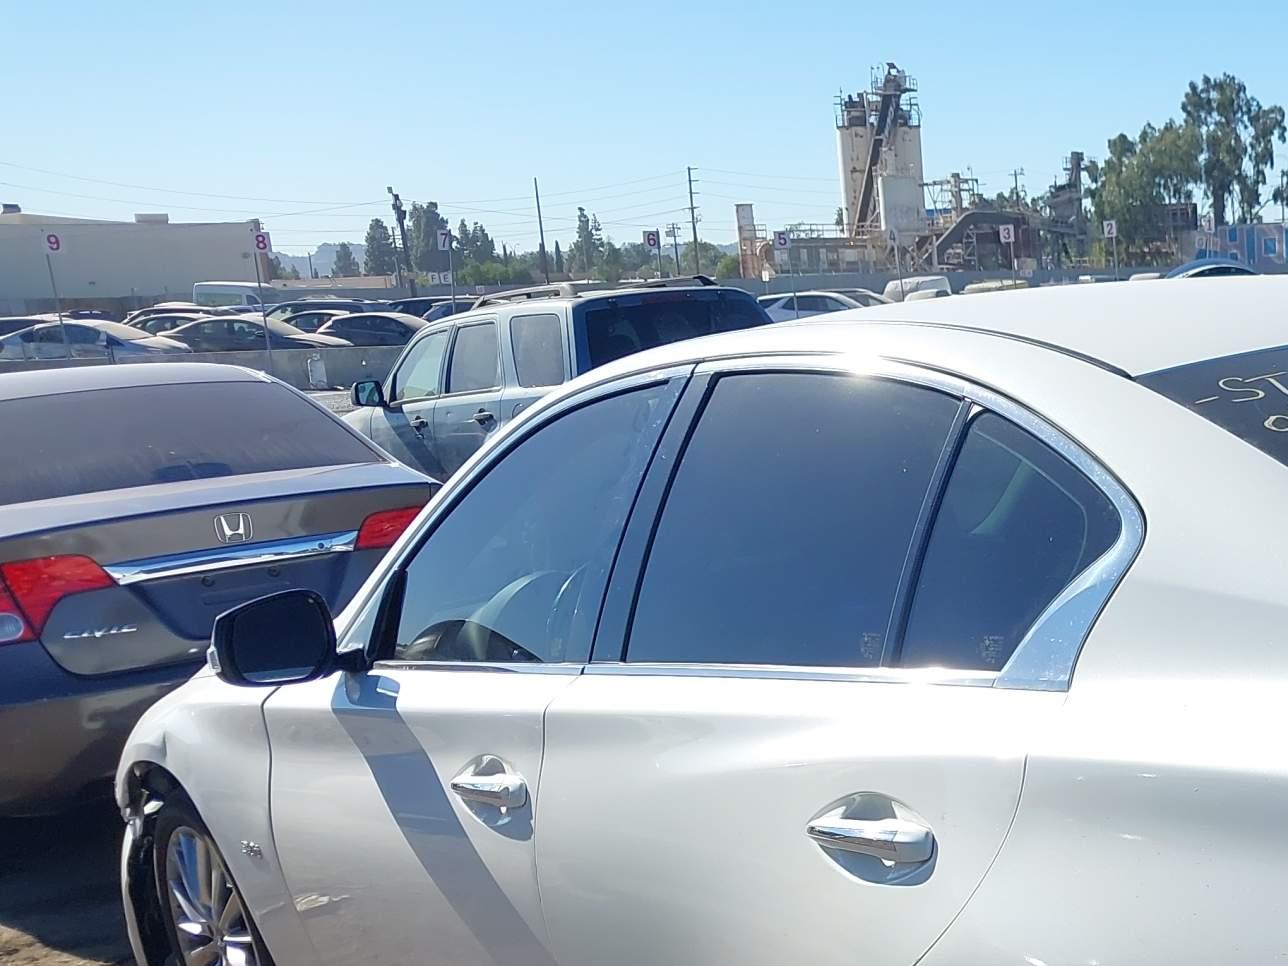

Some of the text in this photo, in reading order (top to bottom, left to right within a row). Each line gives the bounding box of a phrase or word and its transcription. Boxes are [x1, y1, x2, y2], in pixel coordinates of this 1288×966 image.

[1002, 227, 1011, 240] 3
[1105, 223, 1114, 236] 2
[46, 234, 61, 251] 9
[255, 234, 268, 250] 8
[440, 232, 449, 249] 7
[646, 232, 657, 247] 6
[777, 232, 787, 246] 5
